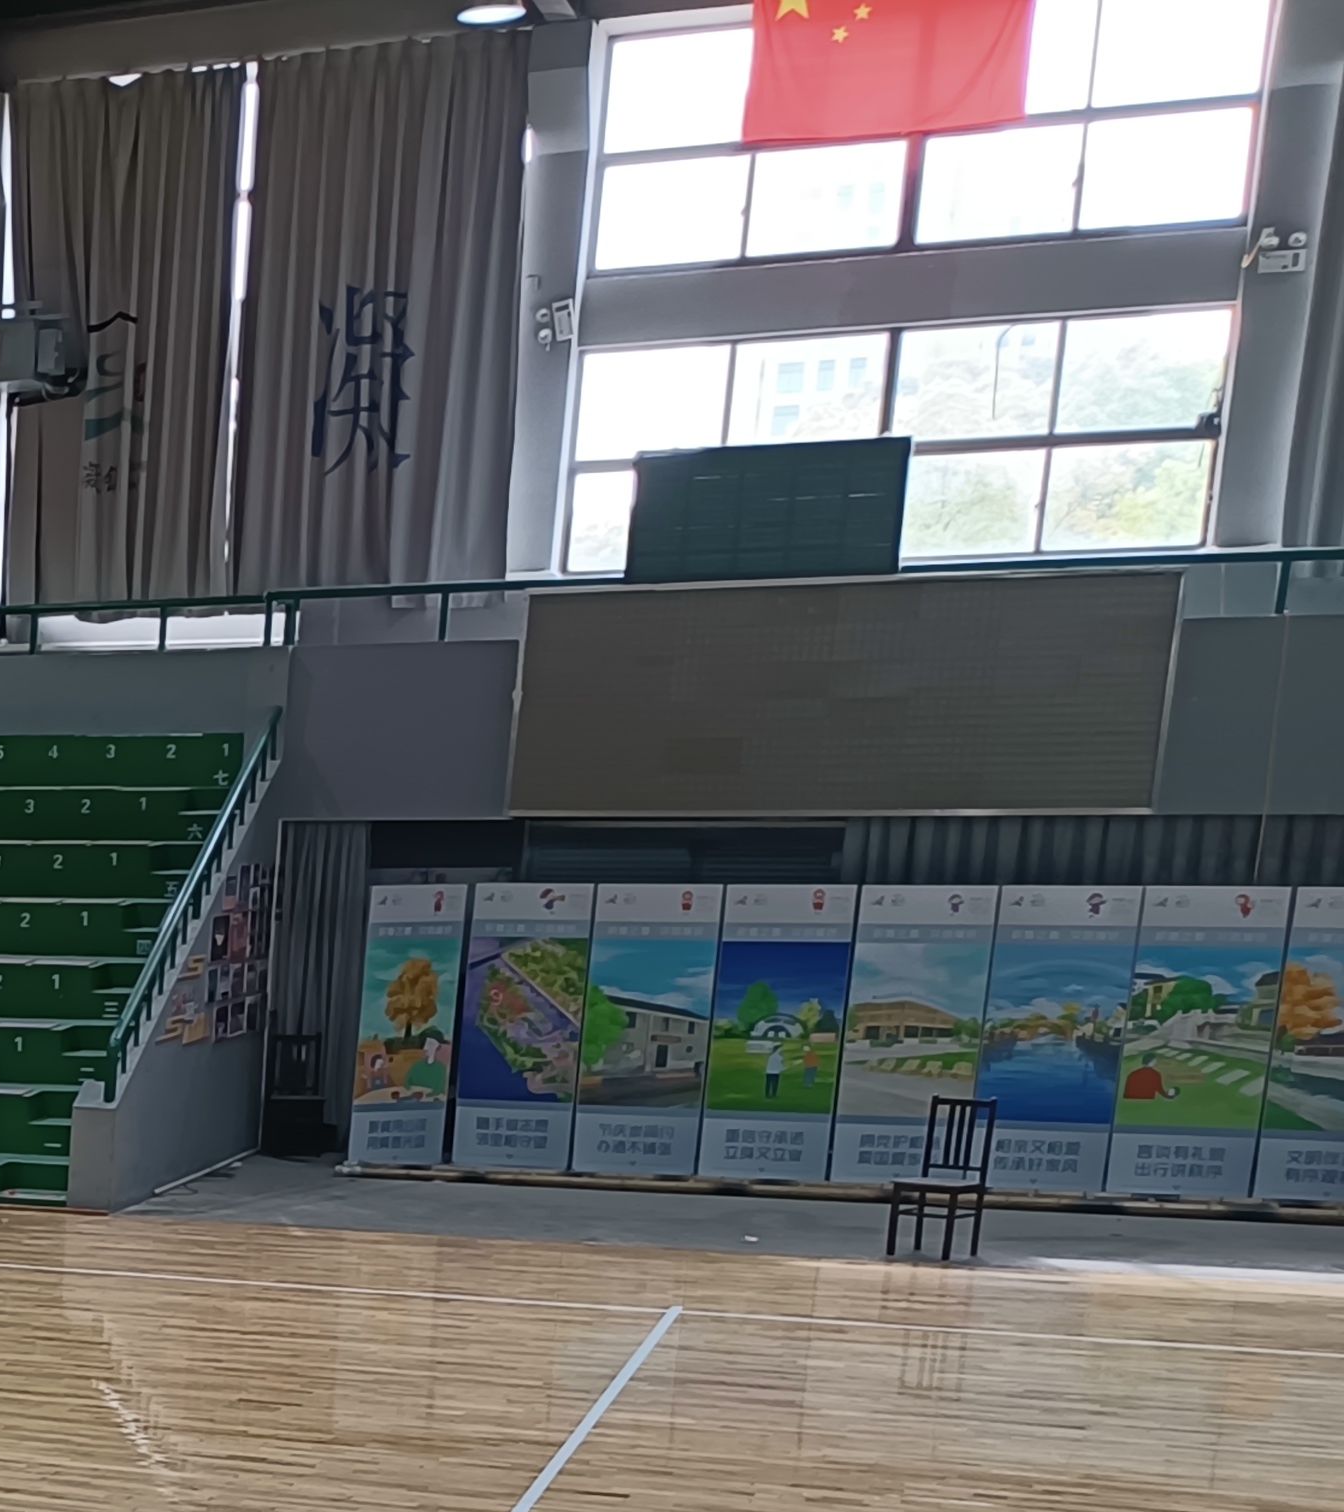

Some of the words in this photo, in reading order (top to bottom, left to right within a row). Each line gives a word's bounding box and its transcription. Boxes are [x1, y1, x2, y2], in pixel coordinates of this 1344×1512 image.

[105, 743, 117, 759] 3
[165, 743, 177, 760] 2
[221, 742, 230, 757] 1
[212, 768, 230, 786] 七
[80, 798, 92, 815] 2
[138, 796, 147, 811] 1
[186, 822, 204, 840] 六
[52, 853, 64, 870] 2
[109, 851, 118, 867] 1
[19, 911, 31, 928] 2
[79, 910, 89, 927] 1
[51, 973, 61, 990] 1
[13, 1035, 23, 1053] 1
